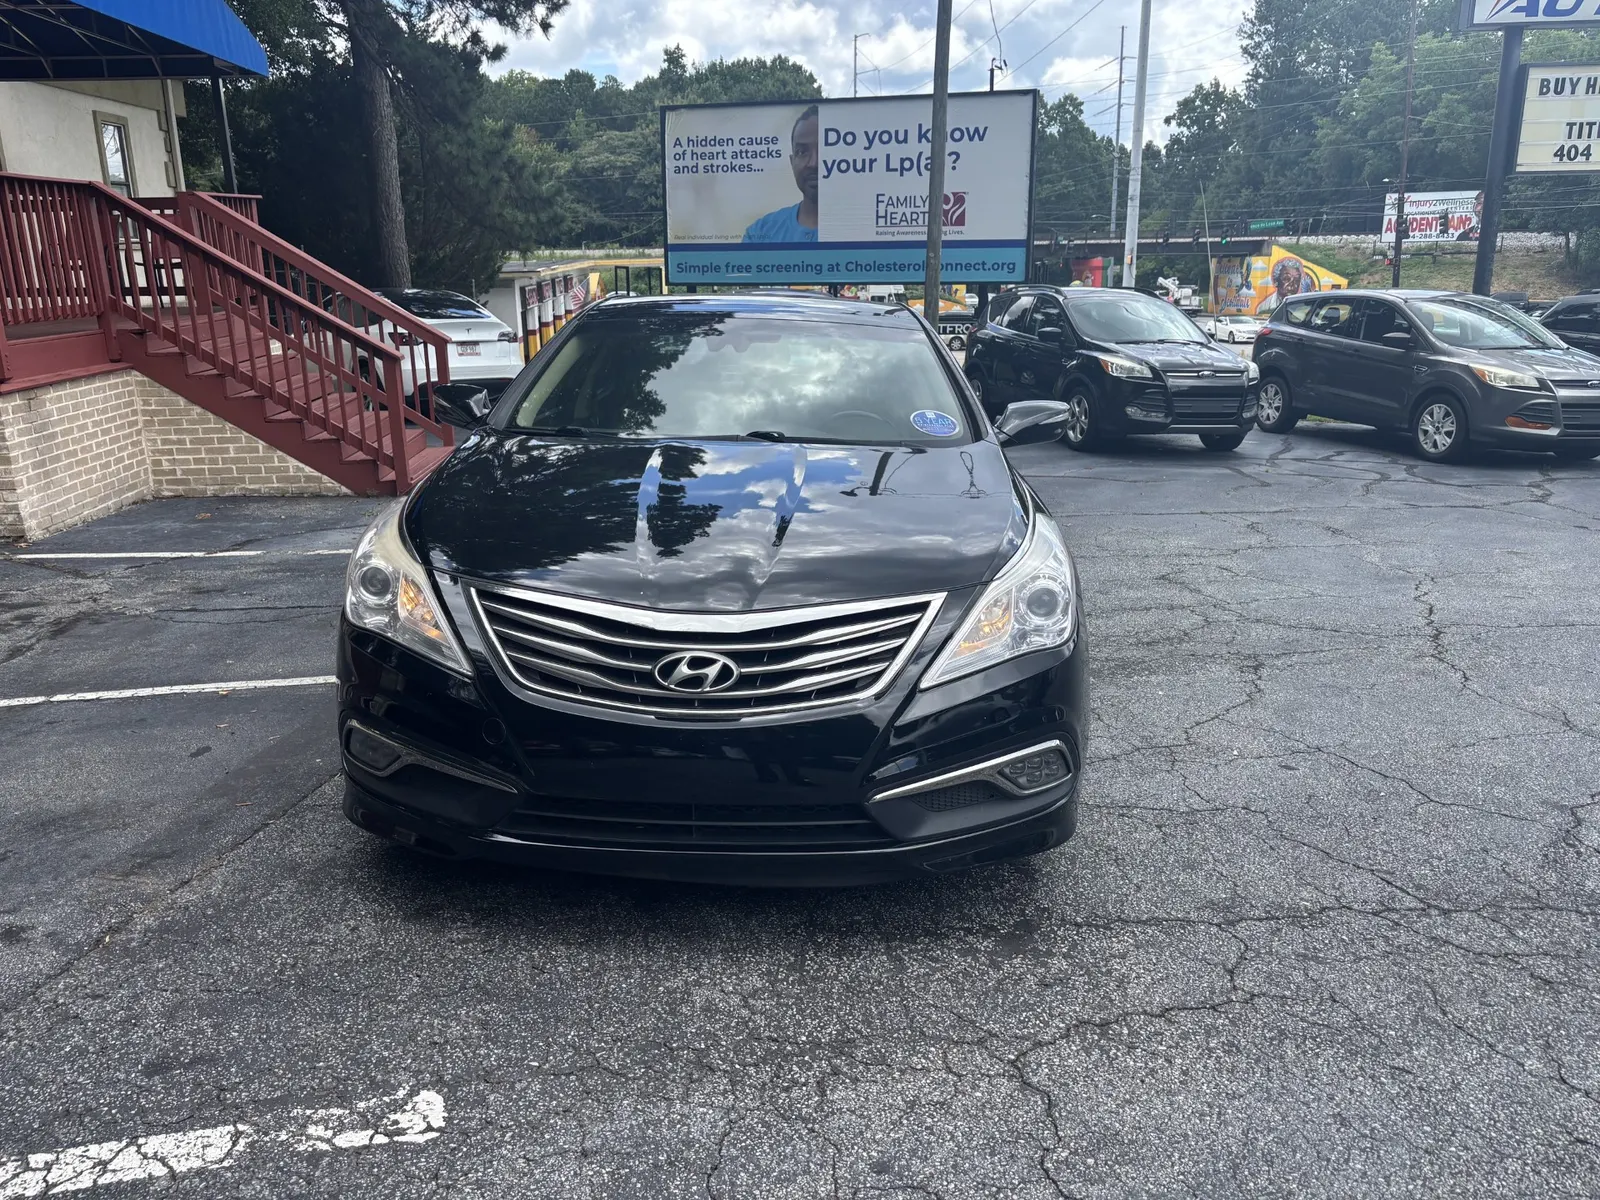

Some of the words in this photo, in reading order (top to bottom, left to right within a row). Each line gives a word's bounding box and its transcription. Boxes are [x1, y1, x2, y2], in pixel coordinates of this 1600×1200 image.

[1539, 77, 1581, 95] BUY
[1585, 77, 1600, 94] H
[673, 138, 683, 148] A
[687, 136, 734, 147] hidden
[738, 136, 779, 146] cause
[823, 128, 857, 146] Do
[863, 129, 908, 150] you
[917, 123, 988, 143] kow
[673, 150, 686, 161] of
[691, 149, 727, 160] heart
[731, 148, 782, 159] attacks
[1553, 144, 1592, 161] 404
[673, 163, 699, 174] and
[703, 162, 764, 173] strokes...
[822, 157, 877, 179] your
[876, 193, 929, 209] FAMILY
[1409, 200, 1474, 209] Injury2Wellness
[875, 209, 928, 226] HEART
[676, 262, 721, 275] Simple
[725, 261, 752, 272] free
[756, 261, 823, 275] screening
[827, 262, 841, 272] at
